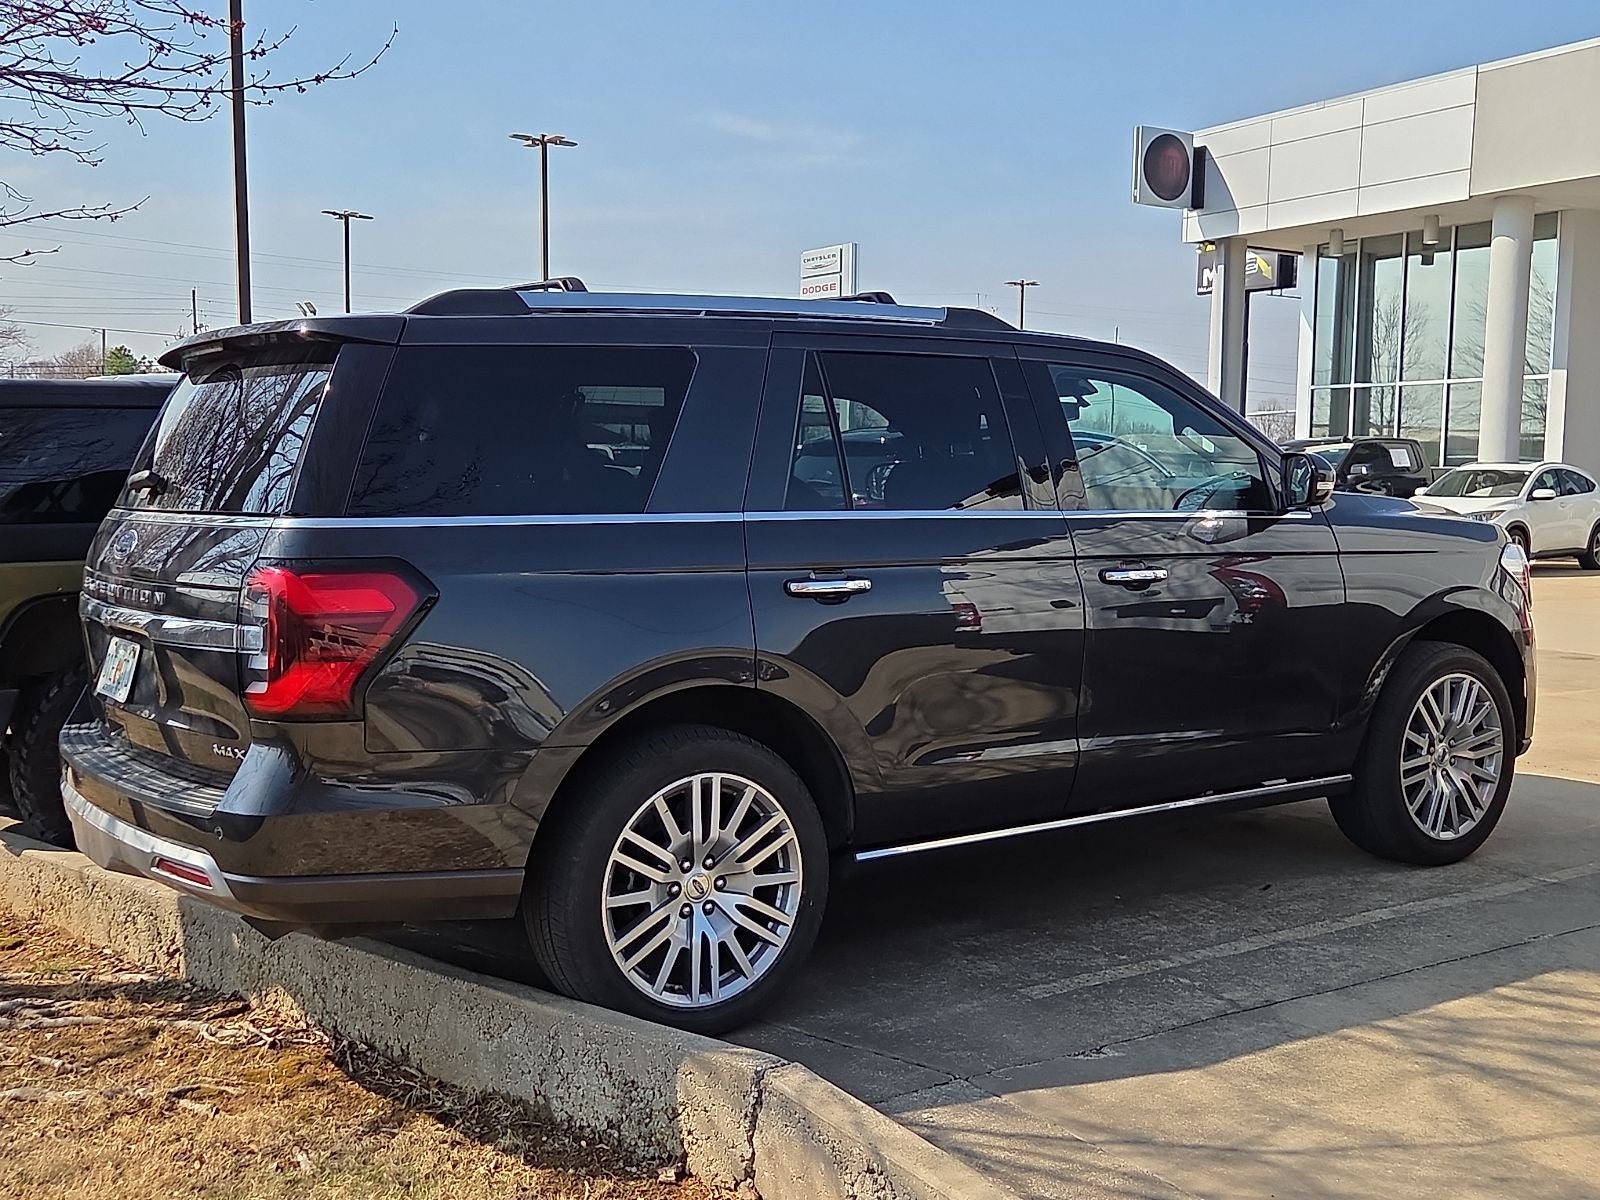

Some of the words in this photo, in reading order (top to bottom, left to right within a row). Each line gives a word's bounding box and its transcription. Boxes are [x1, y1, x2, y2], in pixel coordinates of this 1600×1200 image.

[803, 253, 837, 264] CHRYSLER
[802, 283, 837, 295] DODGE
[212, 743, 246, 760] MAX
